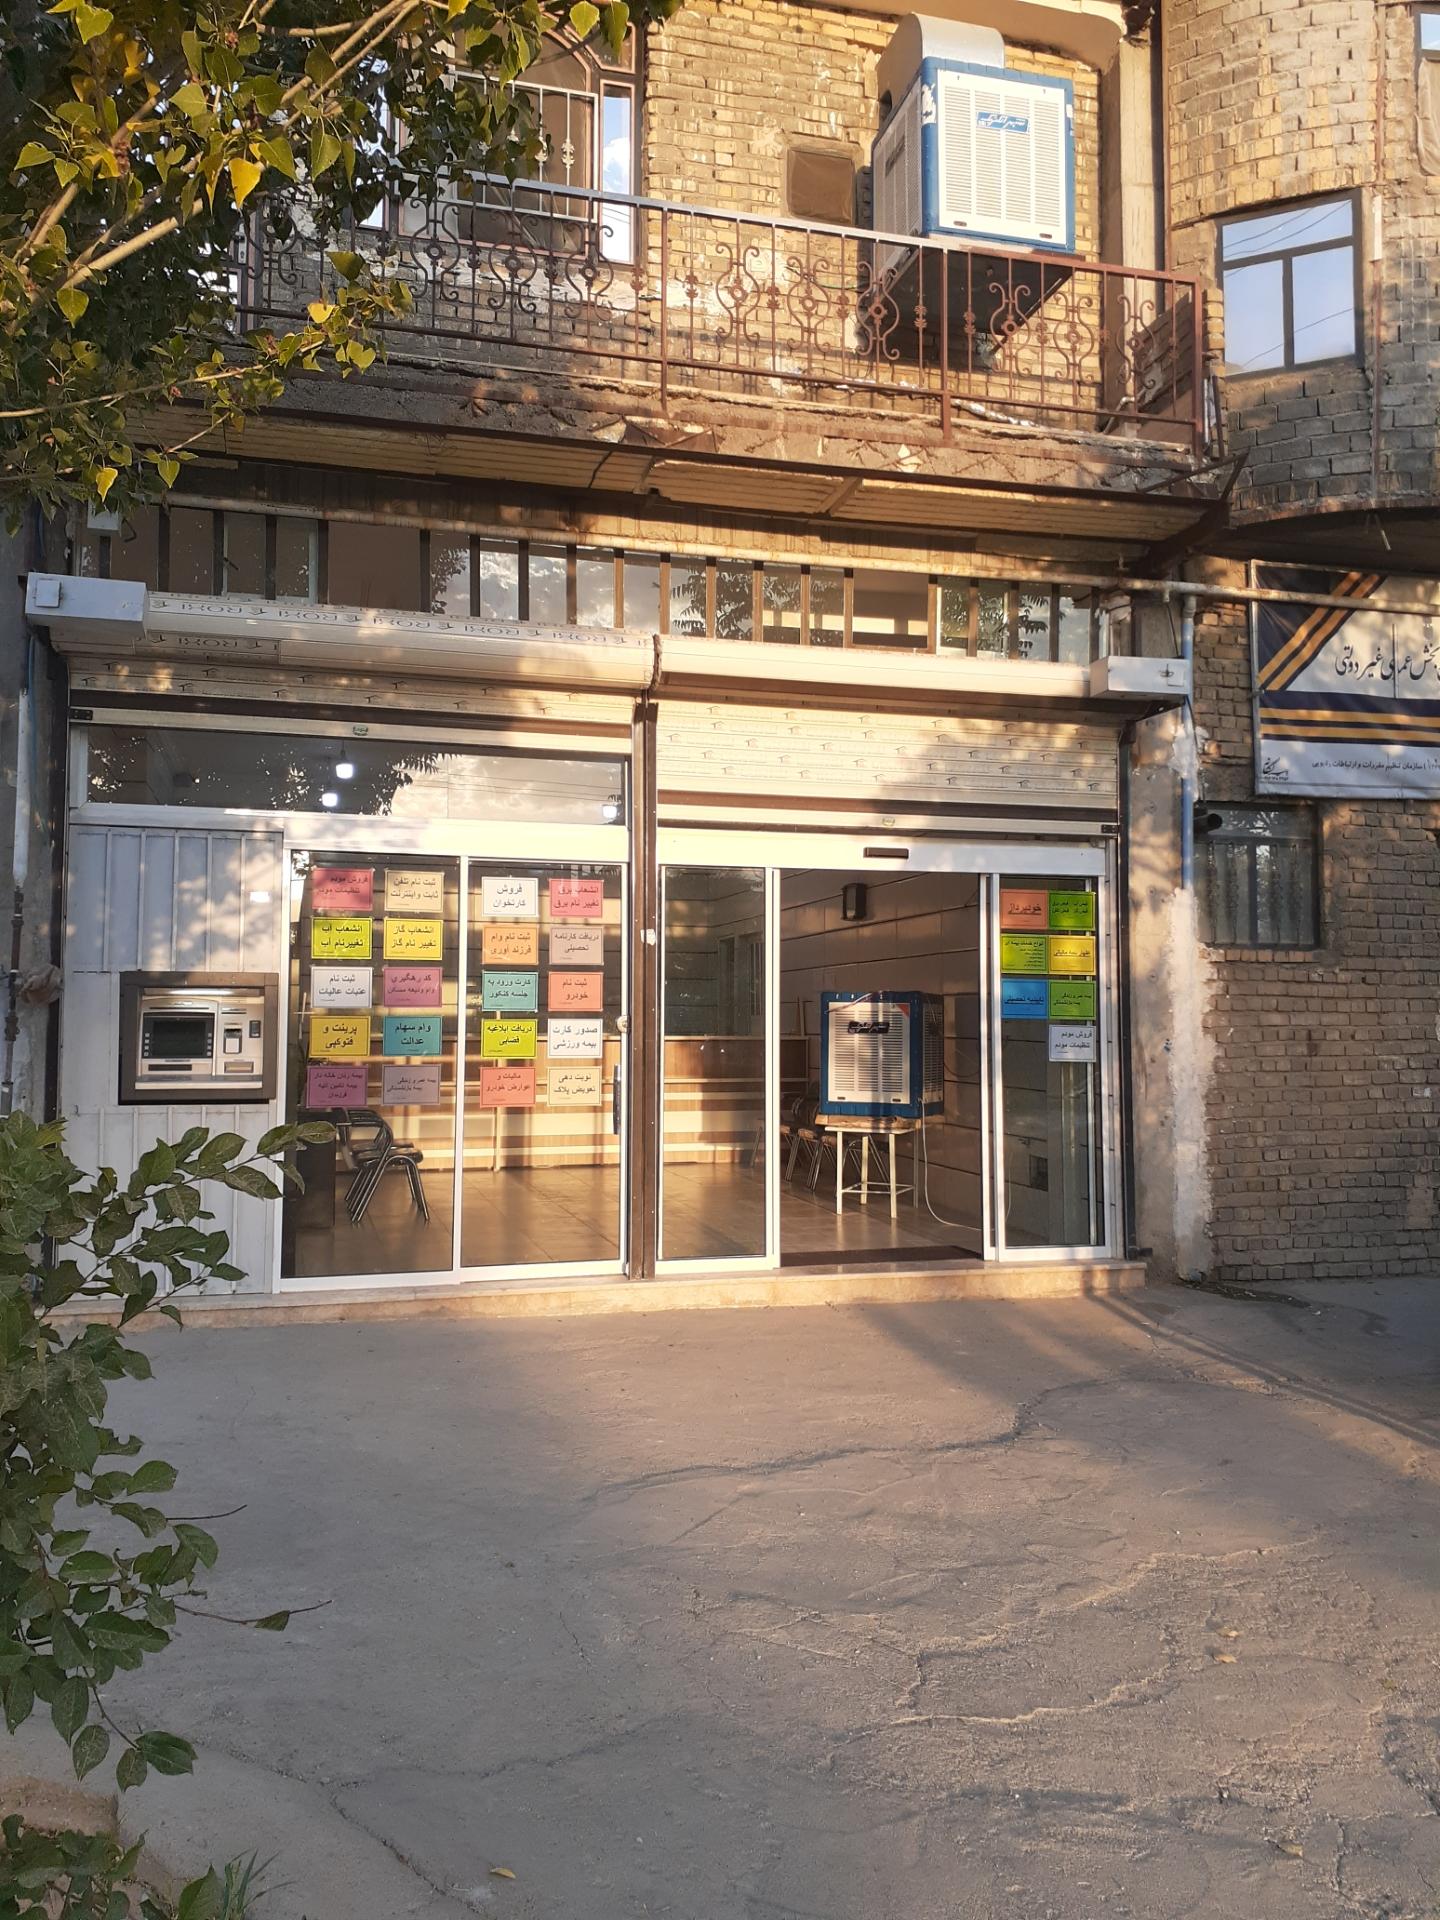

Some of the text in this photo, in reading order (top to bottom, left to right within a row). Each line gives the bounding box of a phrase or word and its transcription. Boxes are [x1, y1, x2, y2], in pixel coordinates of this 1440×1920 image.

[1335, 646, 1359, 676] دولتی
[393, 876, 436, 887] ثبت نام تلفن
[497, 883, 522, 895] فروش
[423, 890, 438, 899] ثابت
[493, 899, 526, 908] کارتخوان
[336, 925, 363, 934] انشعاب
[393, 925, 434, 935] انشعاب گاز
[490, 932, 531, 943] ثبت نام وام
[555, 932, 599, 942] دریافت کارنامه
[391, 939, 437, 949] تغییر نام گاز
[329, 974, 355, 984] ثبت نام
[497, 979, 513, 987] ورود
[515, 978, 531, 987] کارت
[562, 978, 588, 988] ثبت نام
[319, 986, 366, 996] عتبات عالیات
[489, 989, 528, 999] جلسه کنکور
[565, 991, 589, 1001] خودرو
[322, 1023, 358, 1035] پرینت و
[394, 1022, 431, 1033] وام سهام
[487, 1024, 532, 1033] دریافت ابلاغیه
[552, 1024, 598, 1035] صدور کارت
[325, 1037, 354, 1049] فتوکپی
[400, 1036, 424, 1046] عدالت
[553, 1039, 597, 1050] بیمه ورزشی
[502, 1071, 521, 1079] مالیات
[559, 1073, 592, 1083] نوبت دهی
[486, 1083, 530, 1093] عوارض خودرو
[554, 1085, 569, 1095] پلاک
